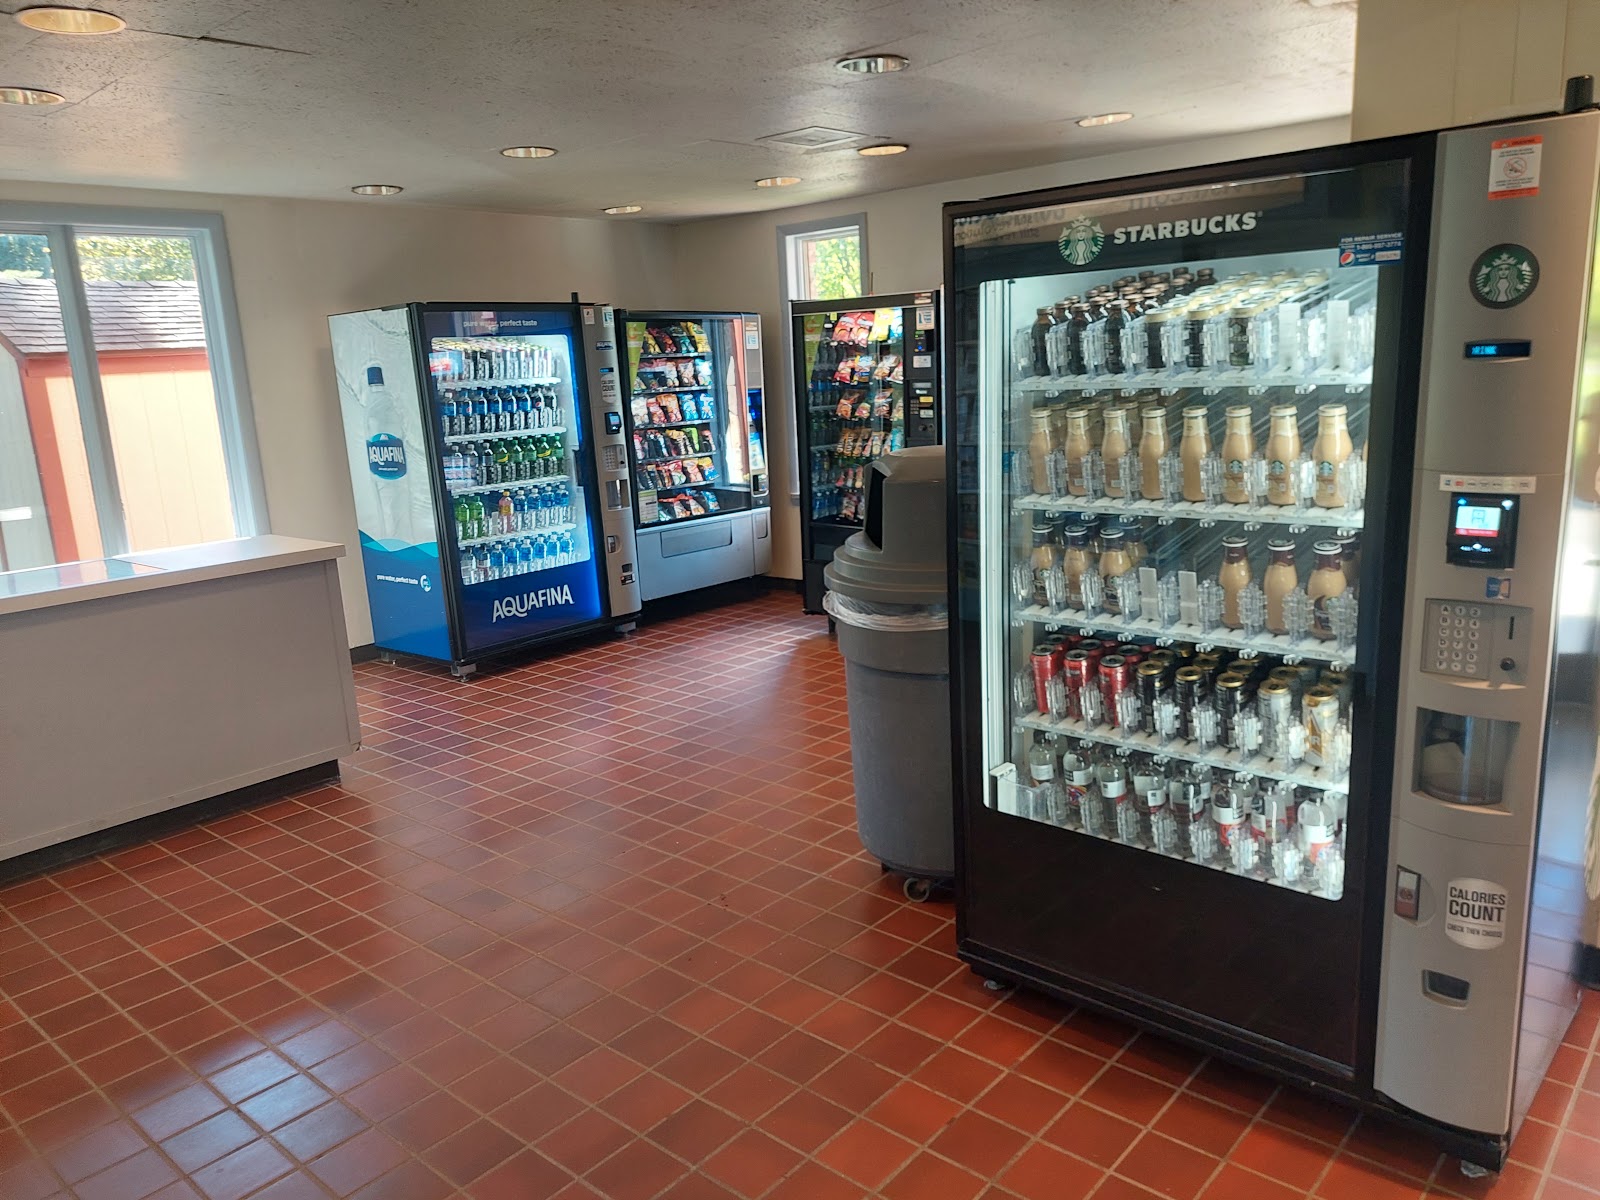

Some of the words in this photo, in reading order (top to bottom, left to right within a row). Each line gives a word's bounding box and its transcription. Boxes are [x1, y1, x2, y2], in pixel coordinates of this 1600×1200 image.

[1113, 210, 1257, 246] STARBUCKS
[499, 319, 522, 328] perfect
[369, 445, 406, 466] AQUAFINA
[492, 584, 574, 623] AQUAFINA
[1450, 887, 1505, 905] CALORIES
[1450, 900, 1504, 922] COUNT
